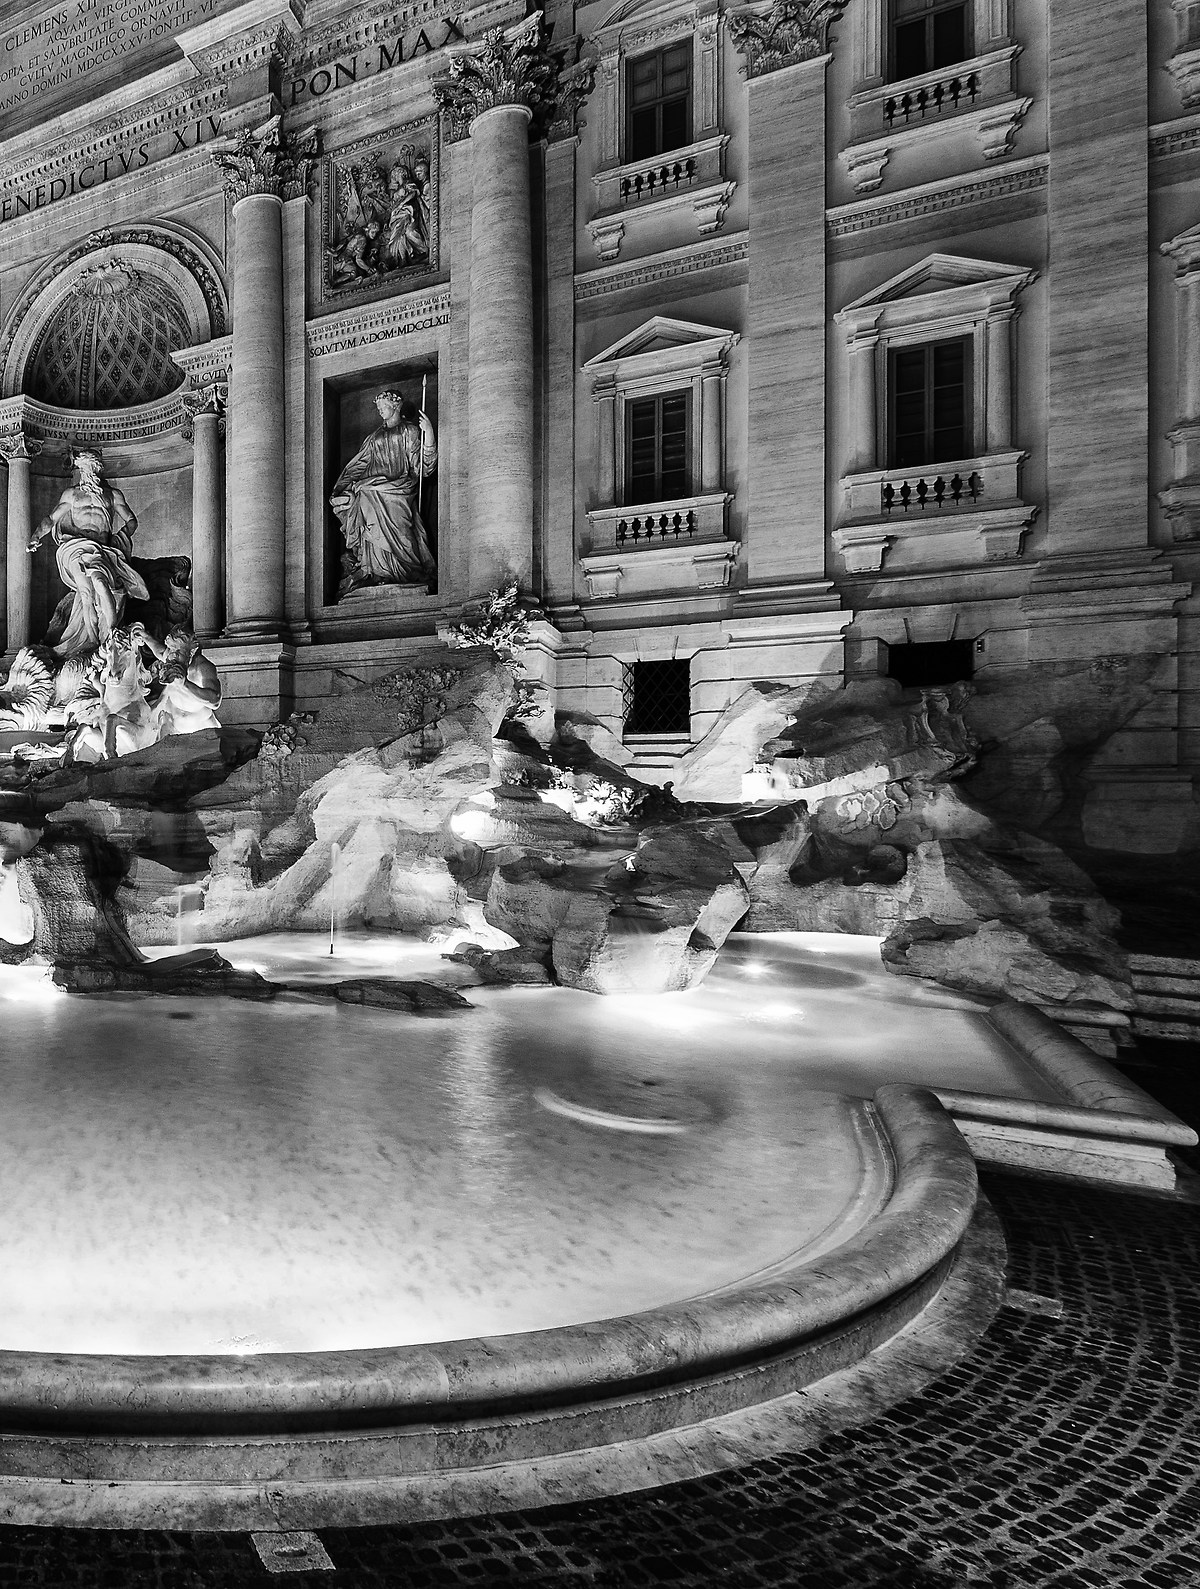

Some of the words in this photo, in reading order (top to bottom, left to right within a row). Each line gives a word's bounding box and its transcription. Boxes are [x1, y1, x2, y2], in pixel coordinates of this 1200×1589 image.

[5, 9, 68, 51] CLEMENS
[28, 55, 40, 69] ET
[44, 18, 115, 61] SALVBRITATE
[47, 17, 88, 46] AQVAM
[377, 11, 468, 73] MAX
[19, 62, 54, 87] CVLTV
[60, 28, 126, 68] MAGNIFICO
[32, 68, 72, 96] DOMINI
[309, 337, 357, 358] SOLVTVM
